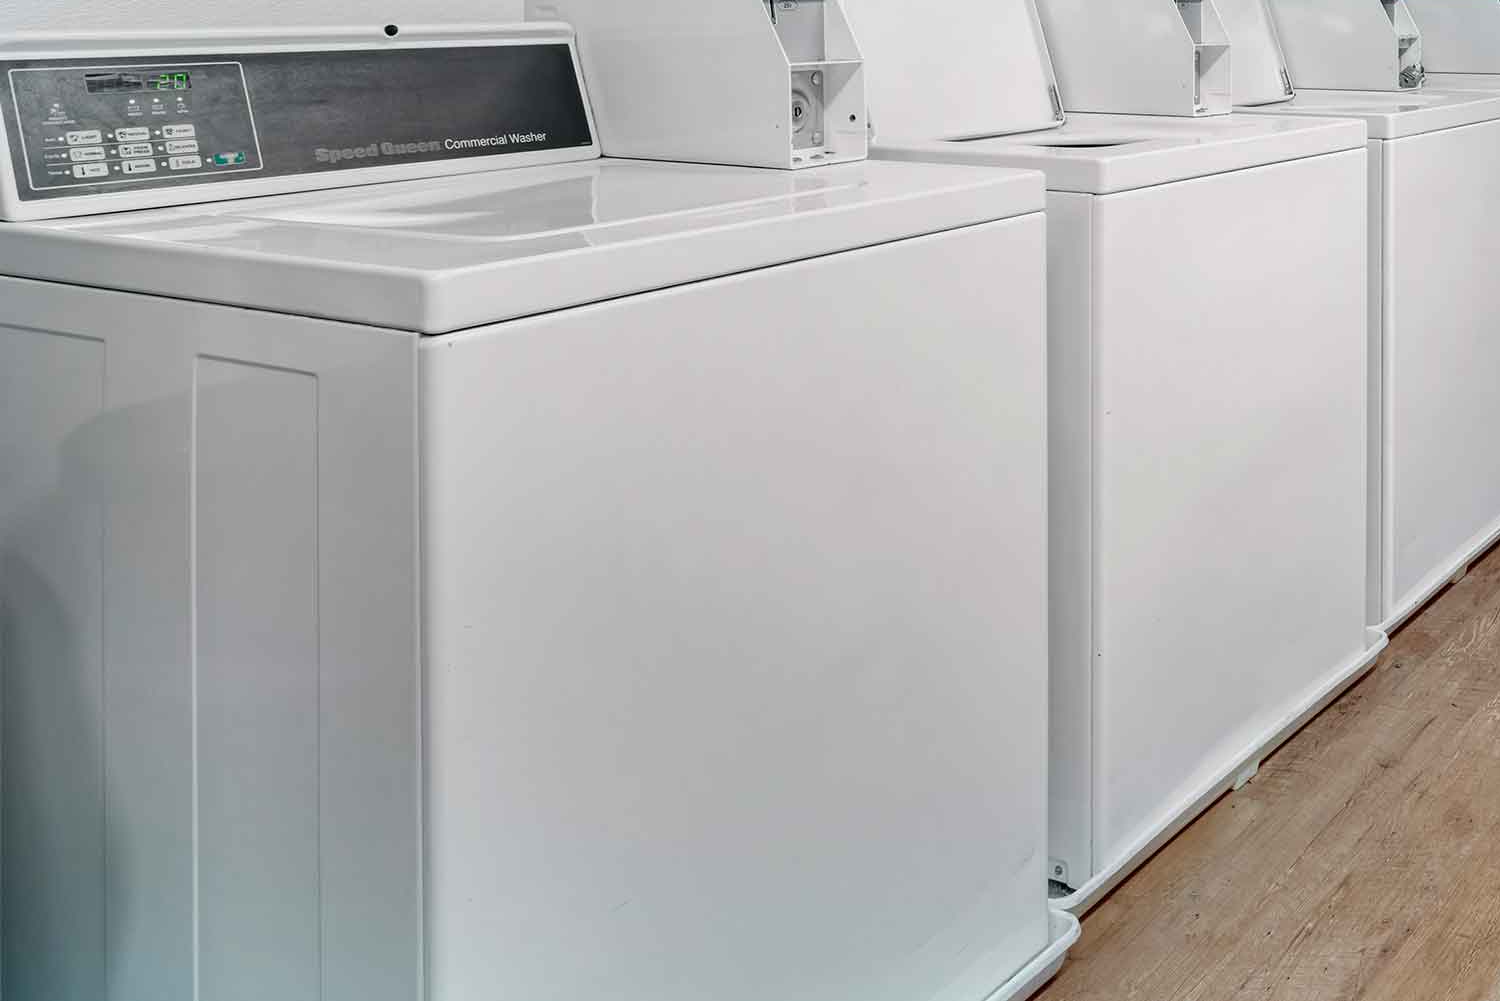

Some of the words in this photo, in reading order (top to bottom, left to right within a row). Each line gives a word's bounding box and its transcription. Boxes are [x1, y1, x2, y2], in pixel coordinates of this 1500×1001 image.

[314, 142, 379, 163] Speed
[380, 140, 443, 156] Queen
[444, 133, 508, 151] Commercial
[508, 130, 547, 145] Washer
